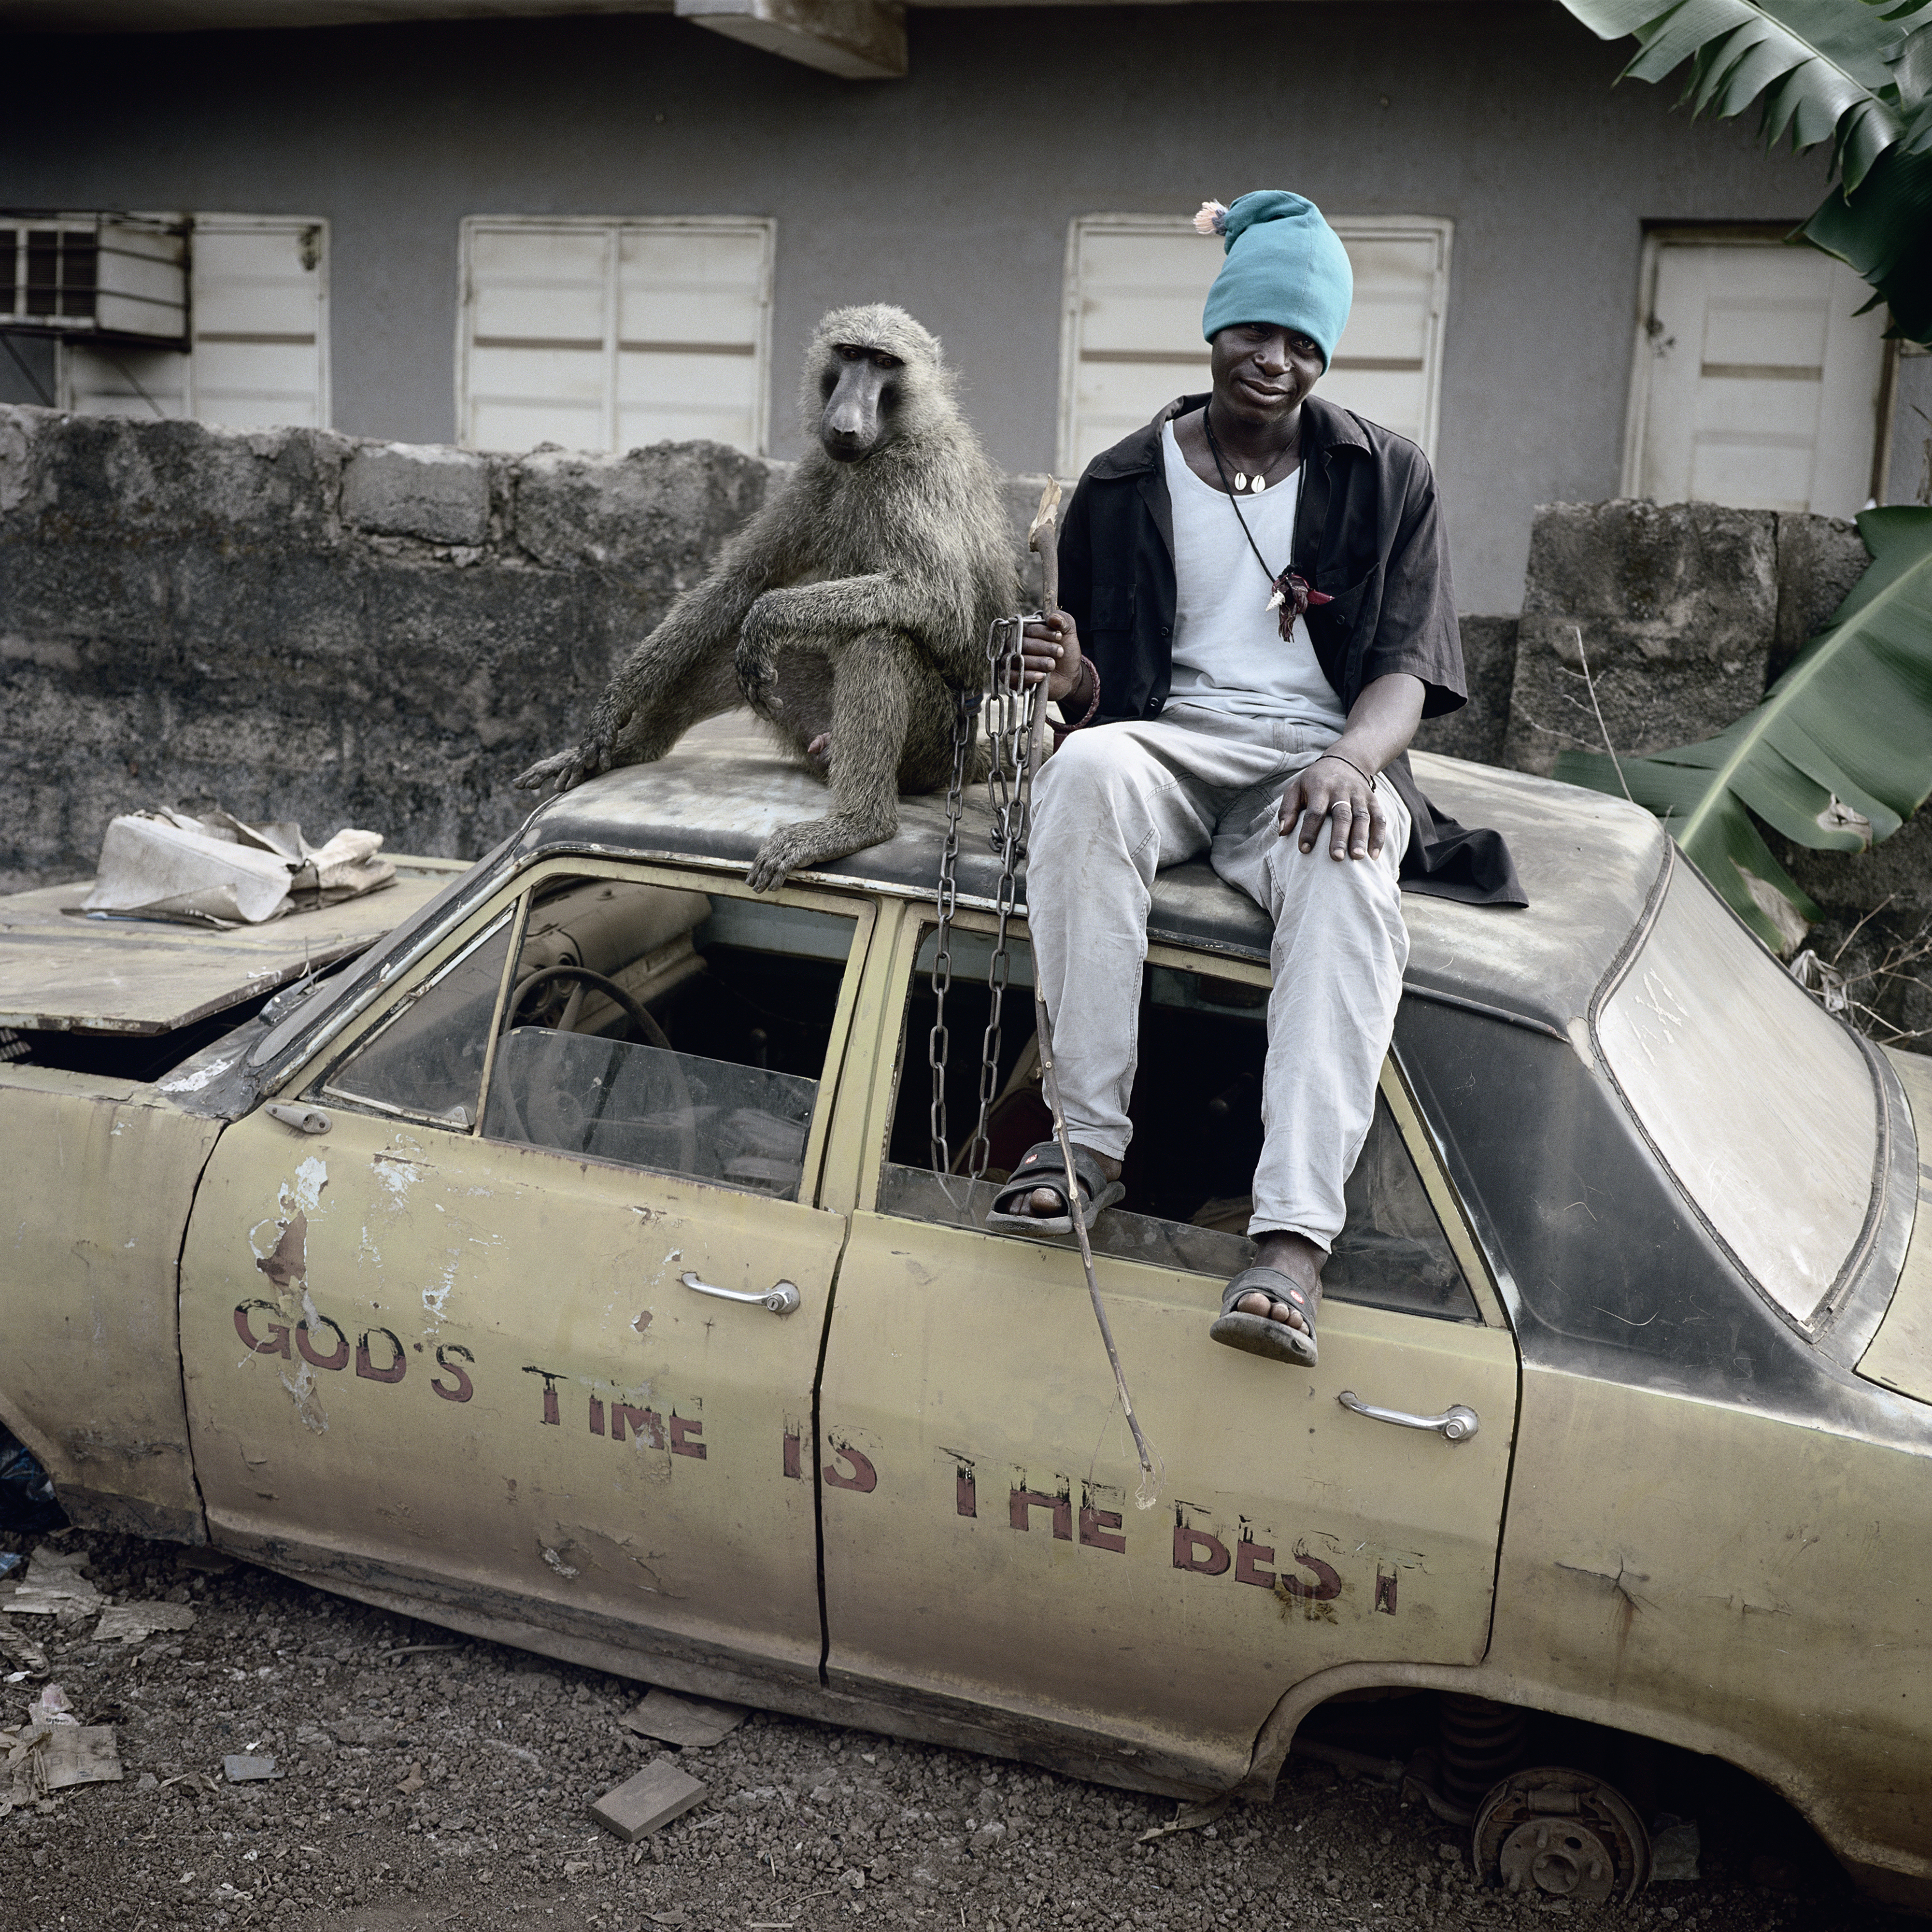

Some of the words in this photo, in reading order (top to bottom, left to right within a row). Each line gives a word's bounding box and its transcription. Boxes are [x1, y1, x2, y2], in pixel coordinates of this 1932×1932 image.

[234, 1298, 476, 1403] GOD'S
[522, 1365, 707, 1460] TIME
[782, 1411, 881, 1493] IS
[937, 1447, 1125, 1553] THE
[1173, 1498, 1427, 1616] BEST
